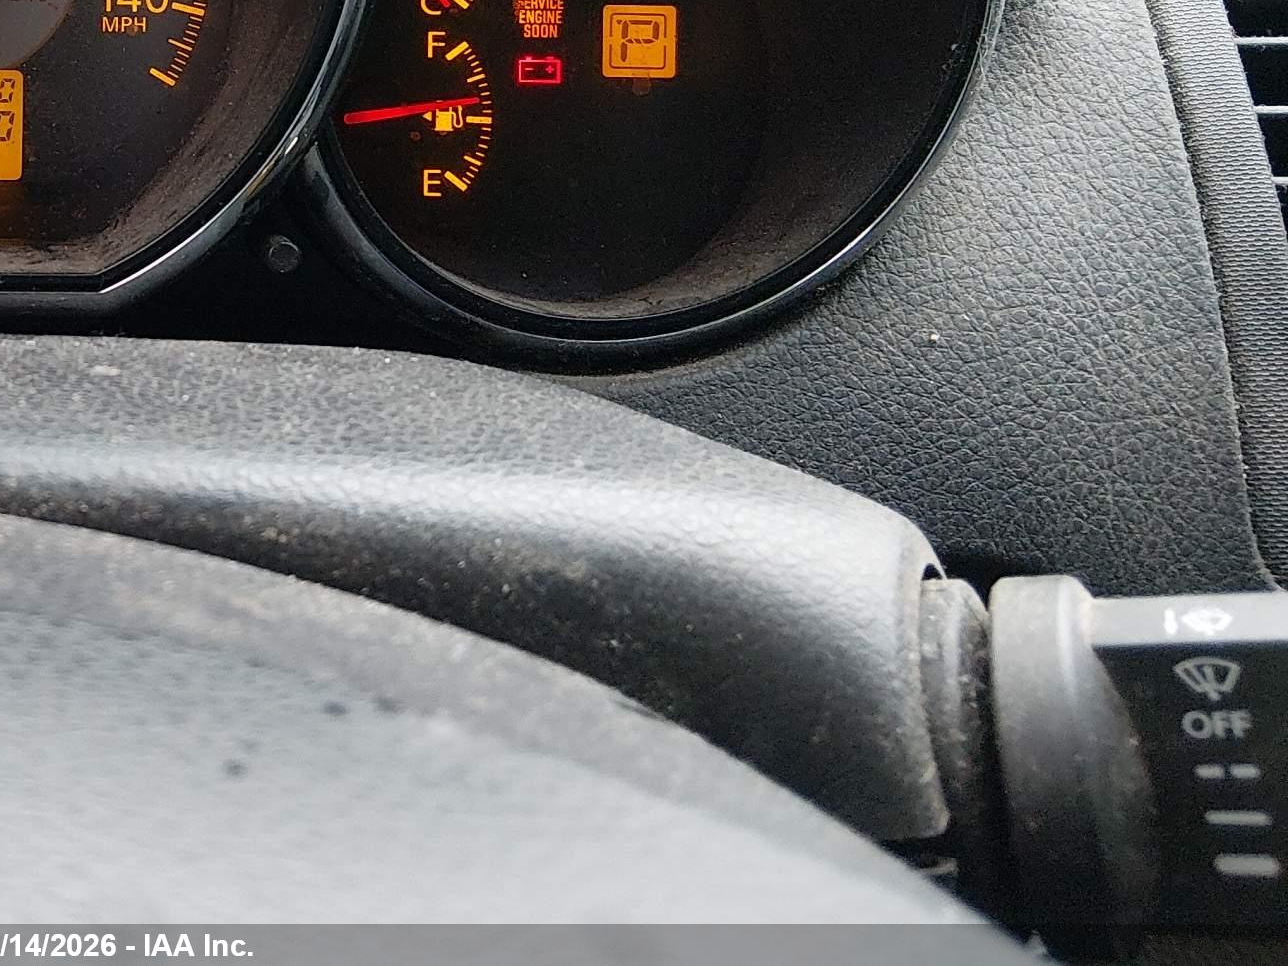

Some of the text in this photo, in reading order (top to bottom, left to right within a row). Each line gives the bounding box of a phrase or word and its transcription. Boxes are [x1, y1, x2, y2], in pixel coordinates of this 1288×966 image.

[101, 17, 147, 33] MPH
[518, 9, 563, 24] ENGINE
[523, 24, 558, 38] SOON
[427, 31, 446, 59] F
[423, 169, 442, 197] E
[1181, 710, 1252, 739] OFF
